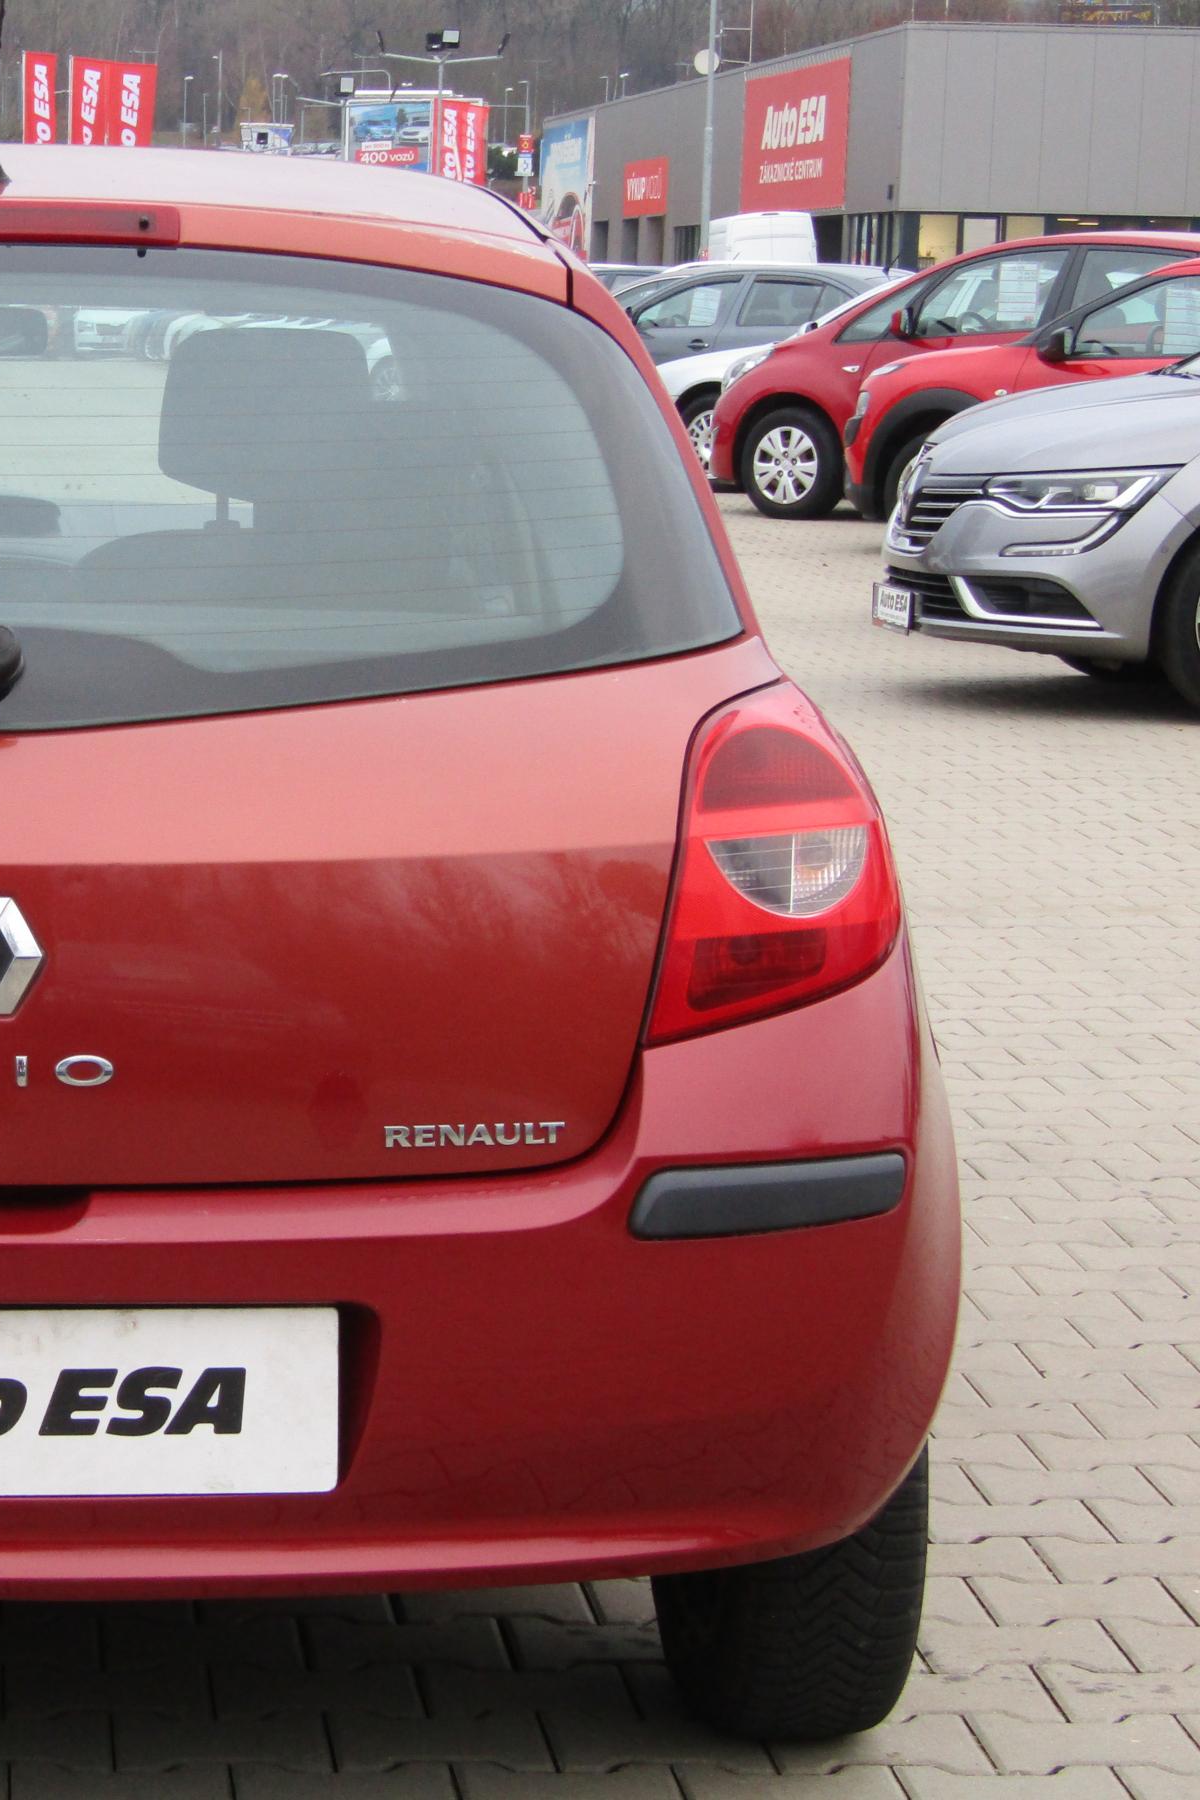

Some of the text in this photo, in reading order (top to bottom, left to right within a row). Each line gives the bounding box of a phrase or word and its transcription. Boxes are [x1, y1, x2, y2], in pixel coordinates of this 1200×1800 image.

[33, 64, 50, 120] ESA
[81, 69, 101, 125] ESA
[121, 73, 141, 128] ESA
[761, 95, 826, 150] Auto ESA
[360, 152, 388, 164] 400
[759, 157, 823, 184] ZÁKAZNICKÉ CENTRUM
[626, 174, 646, 201] VÝKUP
[384, 1121, 566, 1147] RENAULT
[38, 1366, 247, 1436] ESA
